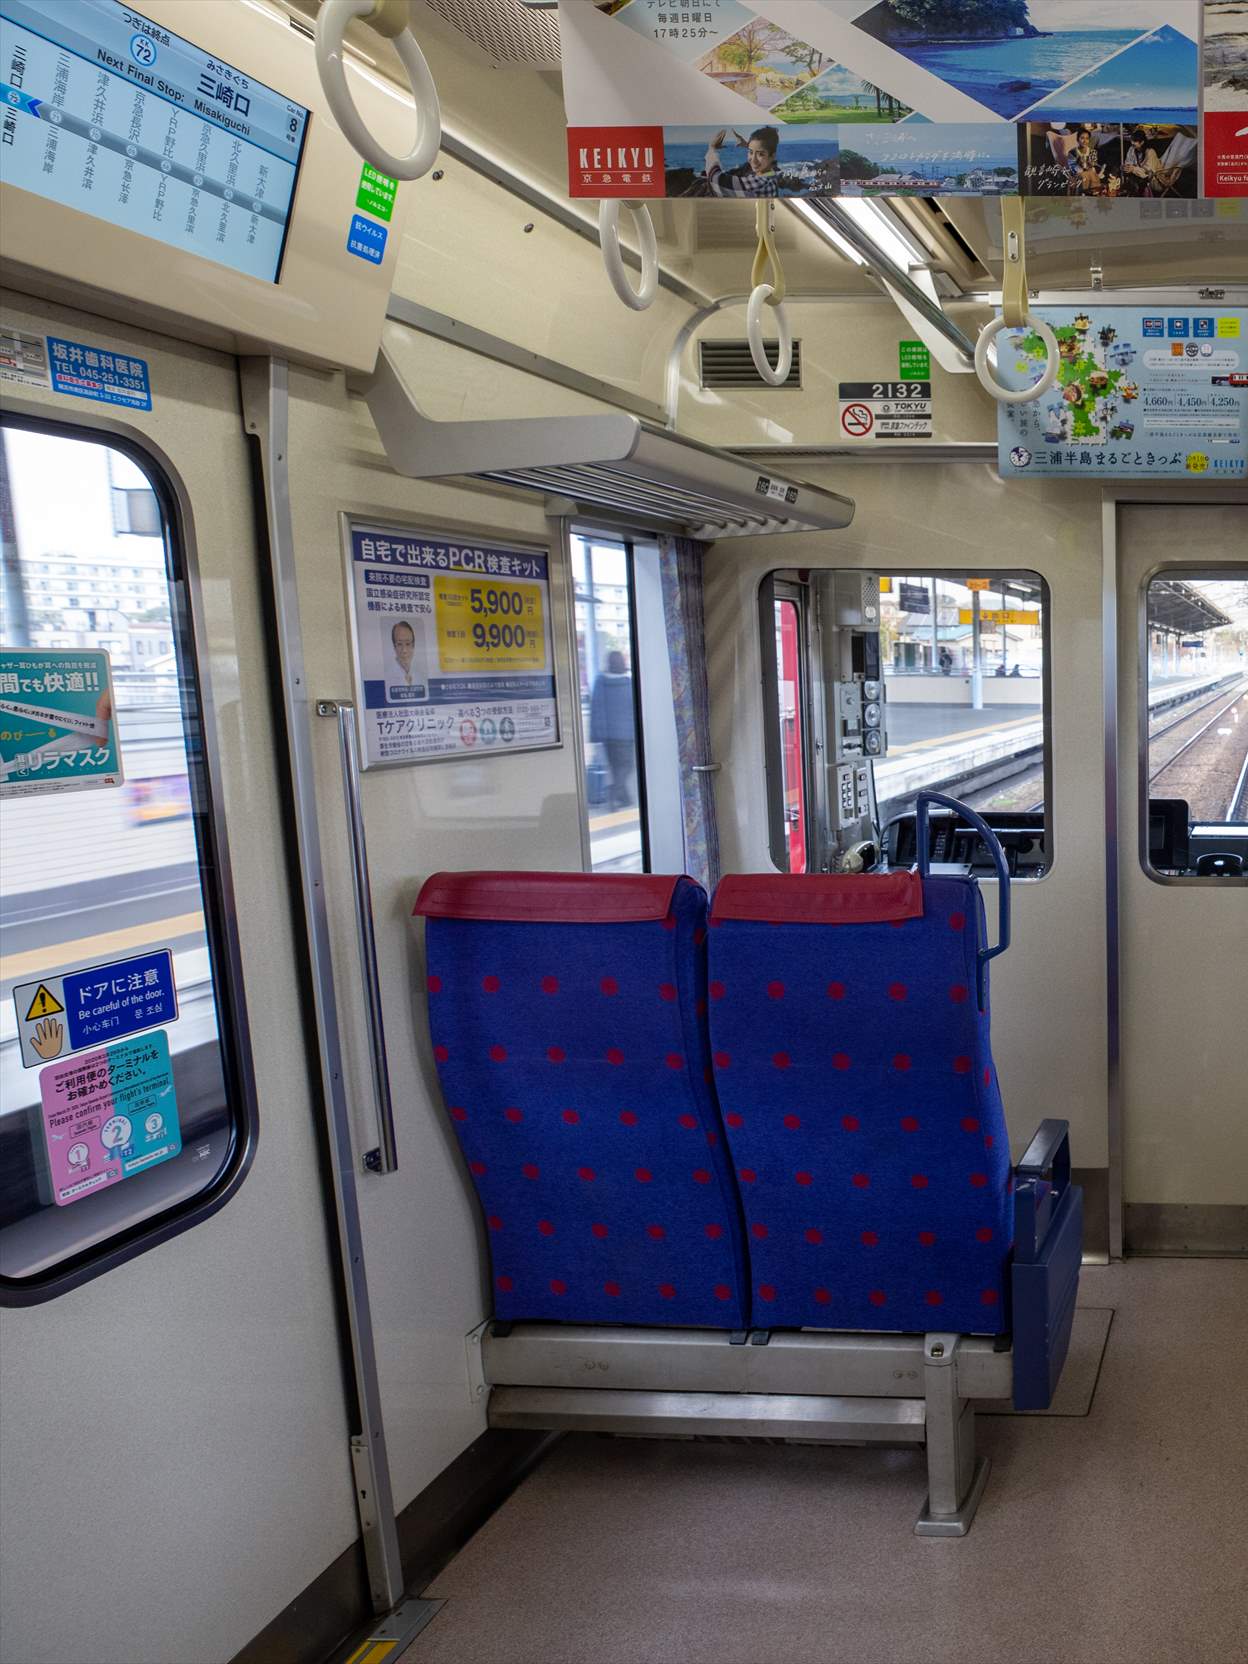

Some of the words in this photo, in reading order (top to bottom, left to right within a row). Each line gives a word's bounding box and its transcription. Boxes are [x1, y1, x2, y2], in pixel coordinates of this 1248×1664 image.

[123, 12, 170, 46] つぎは終点
[658, 12, 712, 23] 毎週日曜日
[136, 44, 152, 62] 72
[10, 45, 28, 89] 三崎口
[206, 60, 249, 89] みさきぐち
[97, 49, 124, 71] Next
[127, 65, 154, 87] Final
[157, 80, 185, 102] Stop:
[194, 99, 250, 136] Misakiguchi
[197, 73, 250, 117] 三崎口
[289, 118, 298, 133] 8
[579, 148, 653, 168] KEIKYU
[1219, 174, 1242, 182] Keikyu
[52, 342, 144, 378] 坂井歯科医院
[55, 361, 77, 375] TEL
[872, 384, 922, 398] 2132
[1034, 451, 1182, 466] 三浦半島まるごときっぷ
[1213, 459, 1244, 468] KEIKYU
[361, 538, 540, 576] 自宅で出来るPCR検査キット
[471, 588, 523, 618] 5,900
[472, 623, 525, 652] 9,900
[0, 671, 100, 694] 間でも快適!!
[377, 716, 455, 735] Tケアクリニック
[28, 747, 110, 771] リラマスク
[80, 969, 159, 1004] ドアに注意
[79, 1010, 91, 1020] Be
[93, 1000, 120, 1015] careful
[122, 997, 130, 1007] of
[131, 995, 143, 1004] the
[145, 990, 165, 1000] door.
[134, 1009, 143, 1019] 문
[146, 1003, 163, 1015] 조심
[82, 1016, 119, 1035] 小心车门
[56, 1050, 160, 1093] ご利用便のターミナルを
[67, 1070, 146, 1100] お確かめください。
[50, 1114, 73, 1128] Please
[75, 1104, 101, 1119] confirm
[103, 1099, 118, 1111] your
[119, 1090, 142, 1104] flight's
[144, 1079, 169, 1093] terminal
[112, 1125, 123, 1144] 2
[151, 1118, 158, 1129] 3
